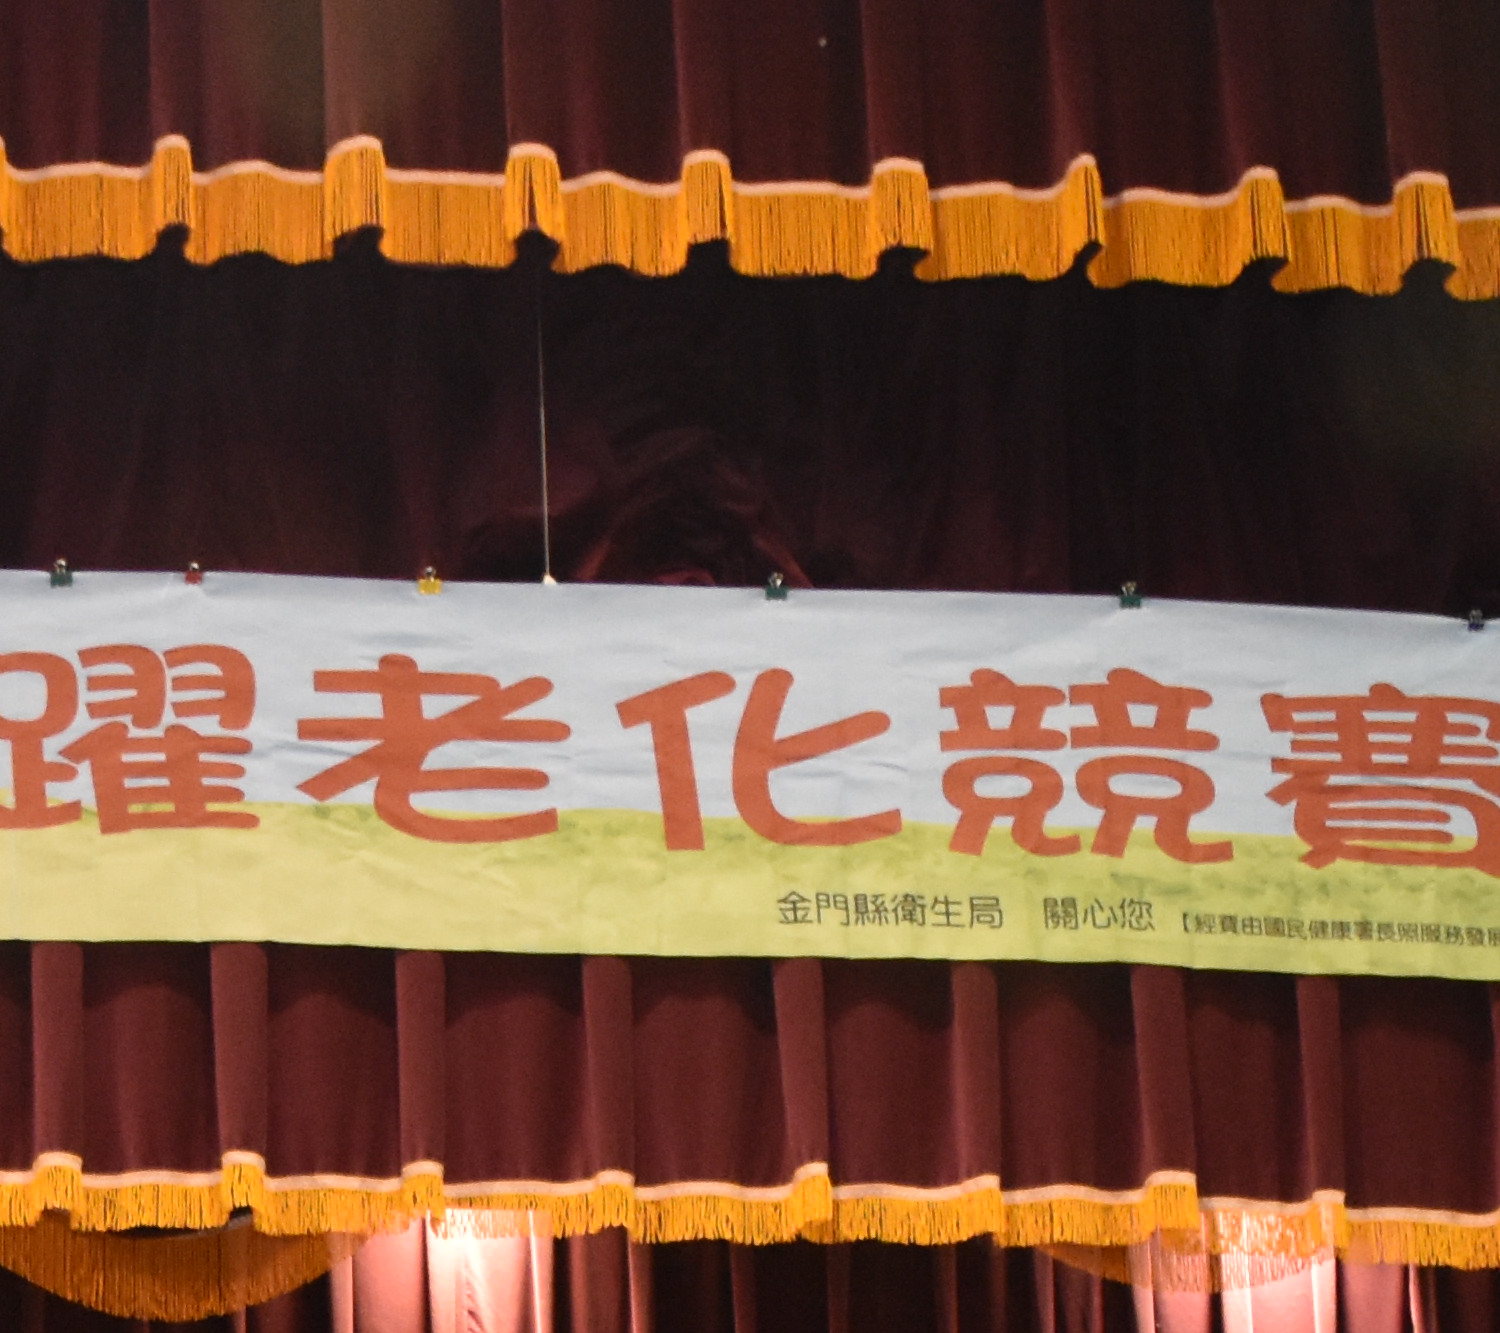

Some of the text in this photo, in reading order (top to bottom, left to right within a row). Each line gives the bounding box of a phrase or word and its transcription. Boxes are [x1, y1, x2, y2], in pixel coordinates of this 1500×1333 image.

[776, 890, 1004, 931] 金門縣衛生局
[1043, 896, 1158, 932] 關心您
